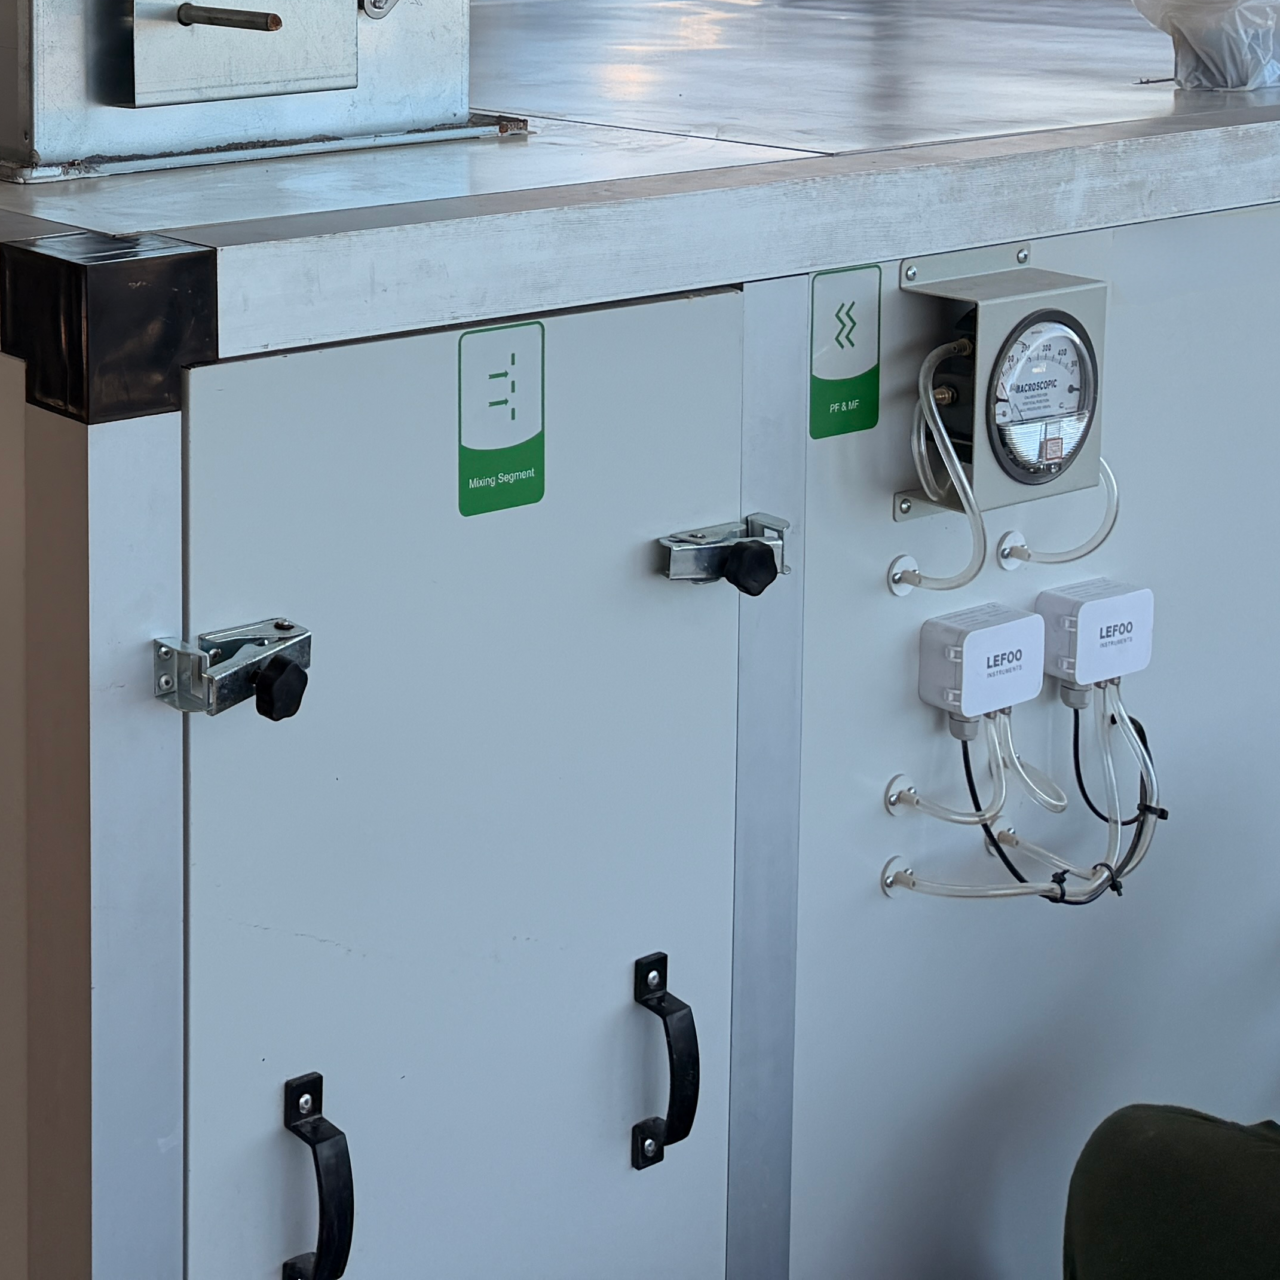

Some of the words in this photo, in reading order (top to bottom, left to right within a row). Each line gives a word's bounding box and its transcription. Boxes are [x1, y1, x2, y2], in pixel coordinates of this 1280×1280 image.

[829, 402, 840, 413] PF
[841, 401, 847, 411] &
[848, 399, 860, 410] MF
[468, 475, 496, 489] Mixing
[497, 467, 535, 483] Segment
[1099, 621, 1134, 640] LEFOO
[986, 648, 1023, 669] LEFOO
